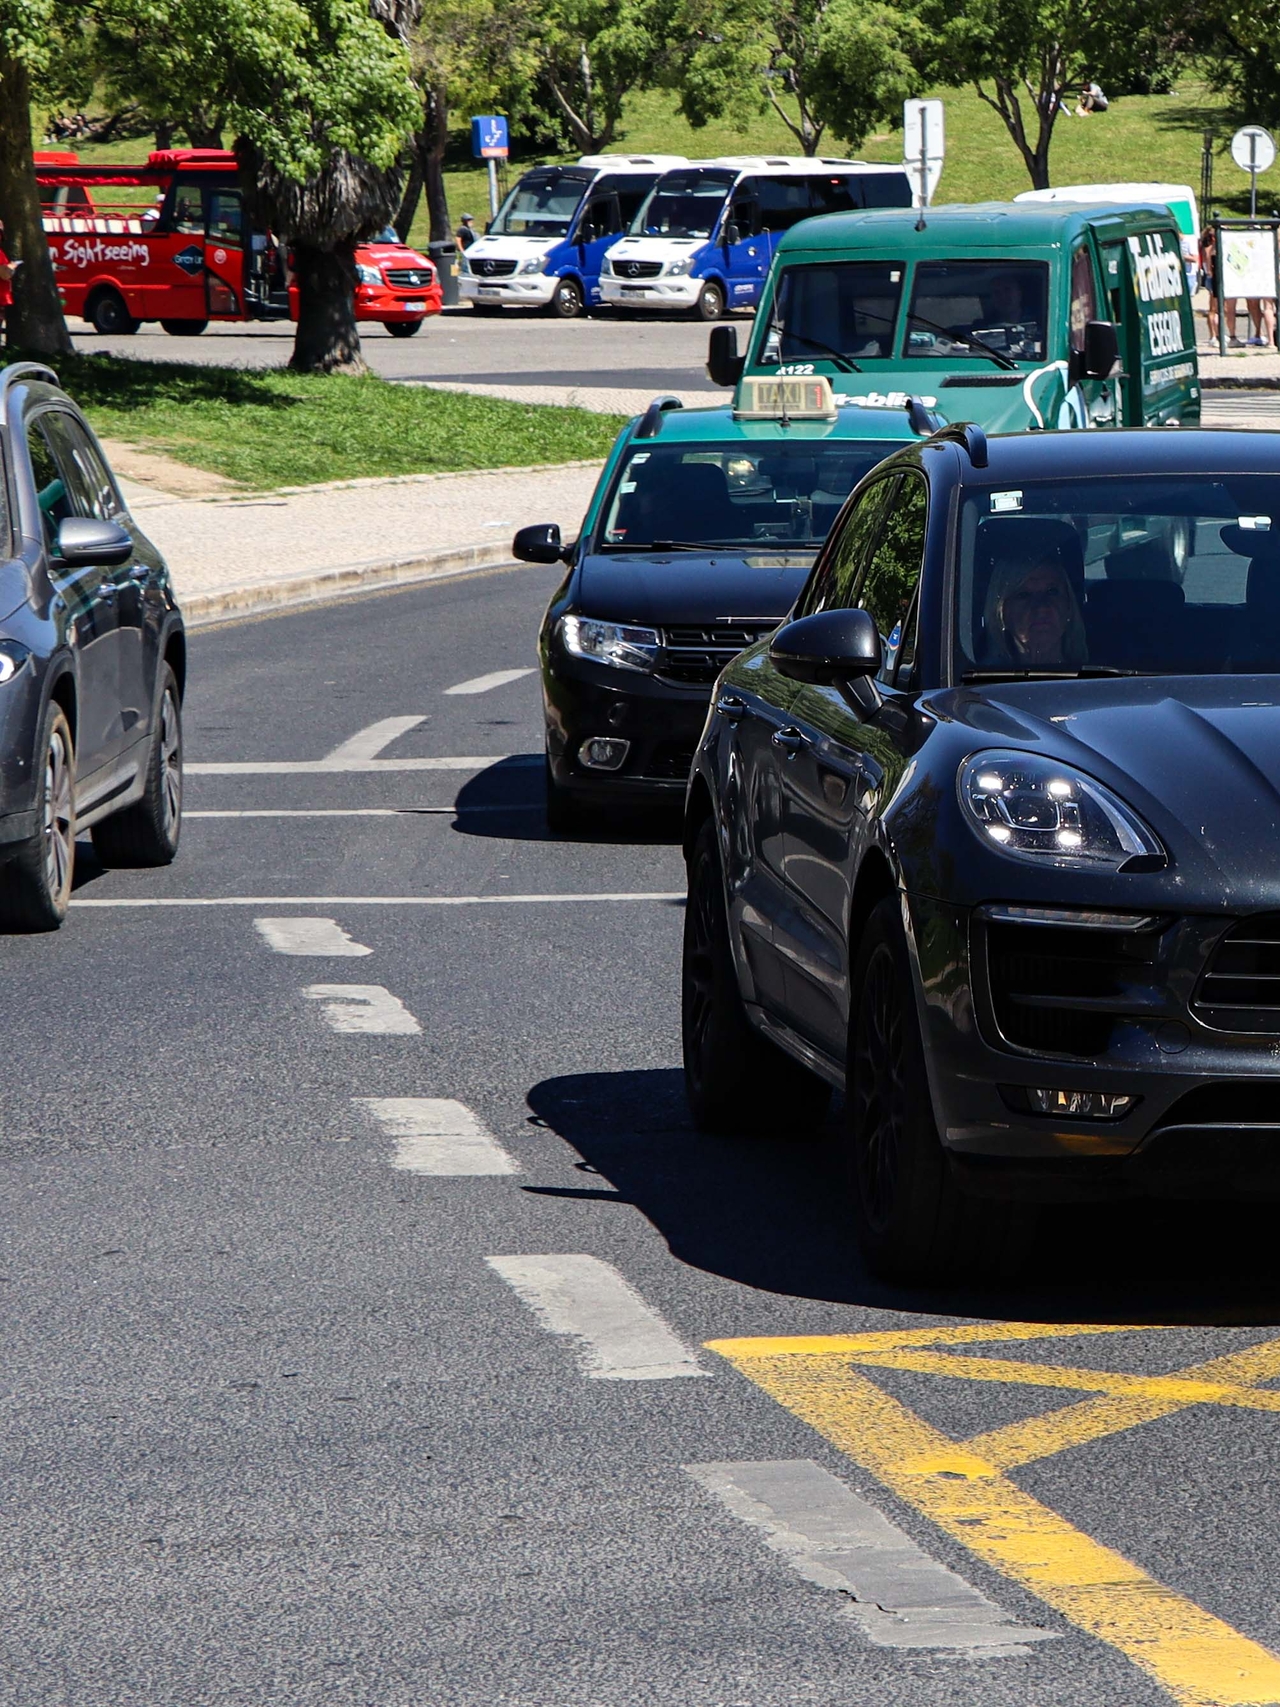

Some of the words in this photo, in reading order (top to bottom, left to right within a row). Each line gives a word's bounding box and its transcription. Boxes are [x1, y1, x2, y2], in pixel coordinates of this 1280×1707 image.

[63, 238, 150, 268] Sightseeing
[1127, 233, 1183, 302] Trablisa
[1147, 310, 1185, 356] ESEGUR
[760, 384, 799, 403] TAXI
